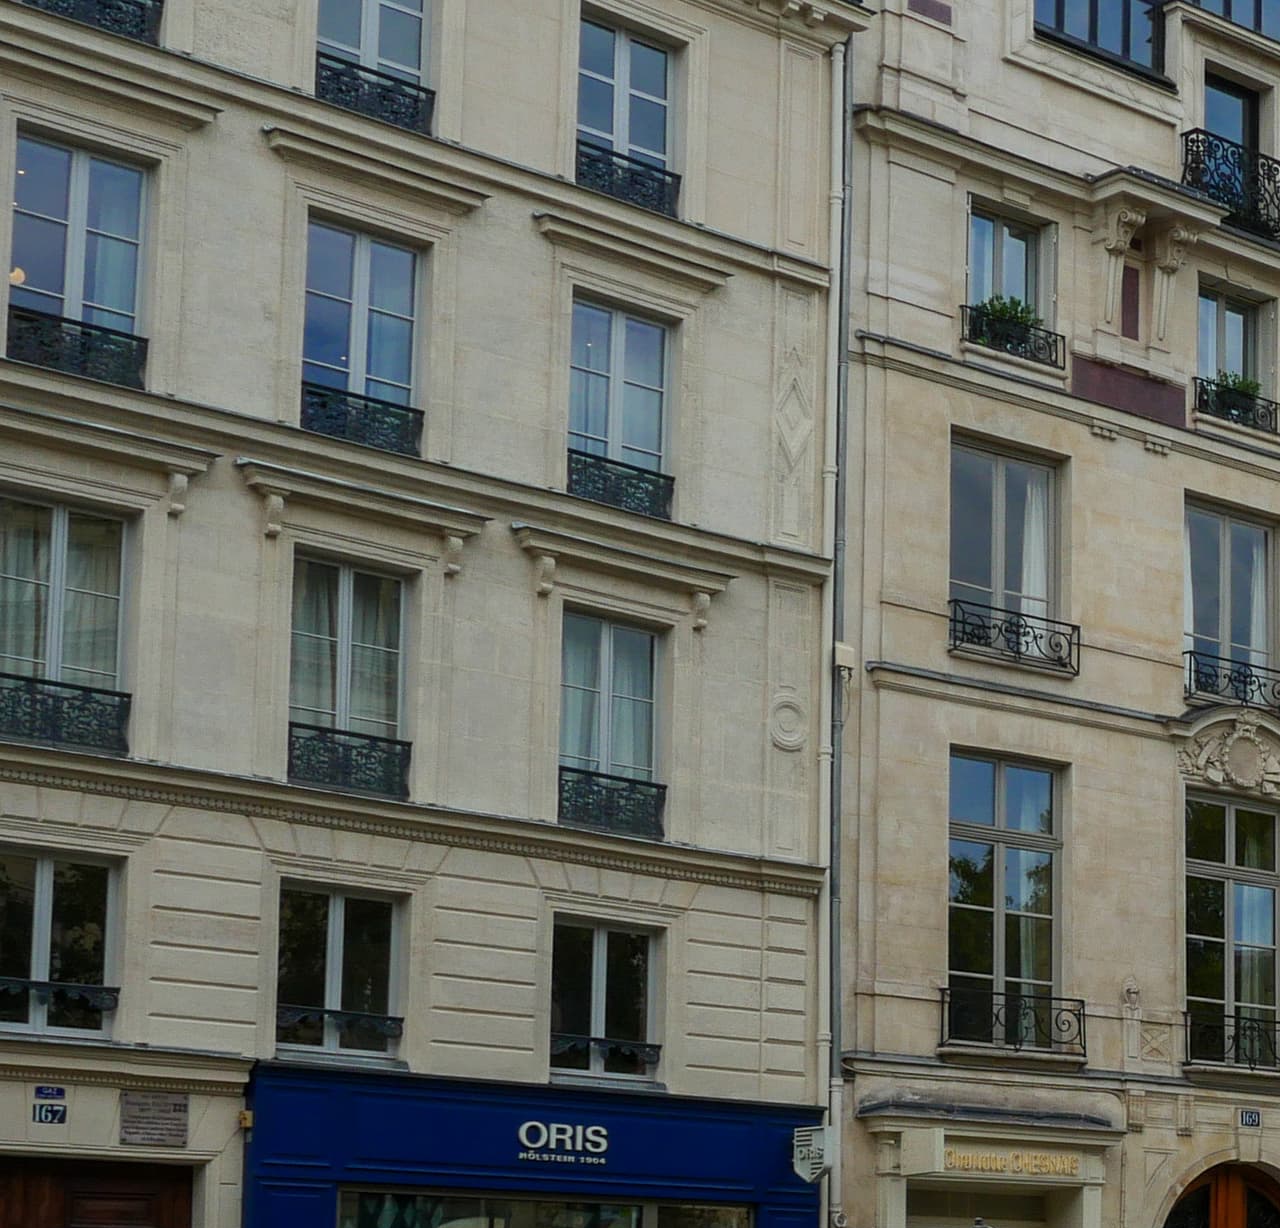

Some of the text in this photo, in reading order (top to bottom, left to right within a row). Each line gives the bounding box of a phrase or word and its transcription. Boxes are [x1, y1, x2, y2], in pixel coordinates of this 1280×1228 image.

[34, 1105, 65, 1123] 167
[1242, 1111, 1259, 1125] 169
[518, 1121, 608, 1153] ORIS
[578, 1156, 606, 1165] 1904
